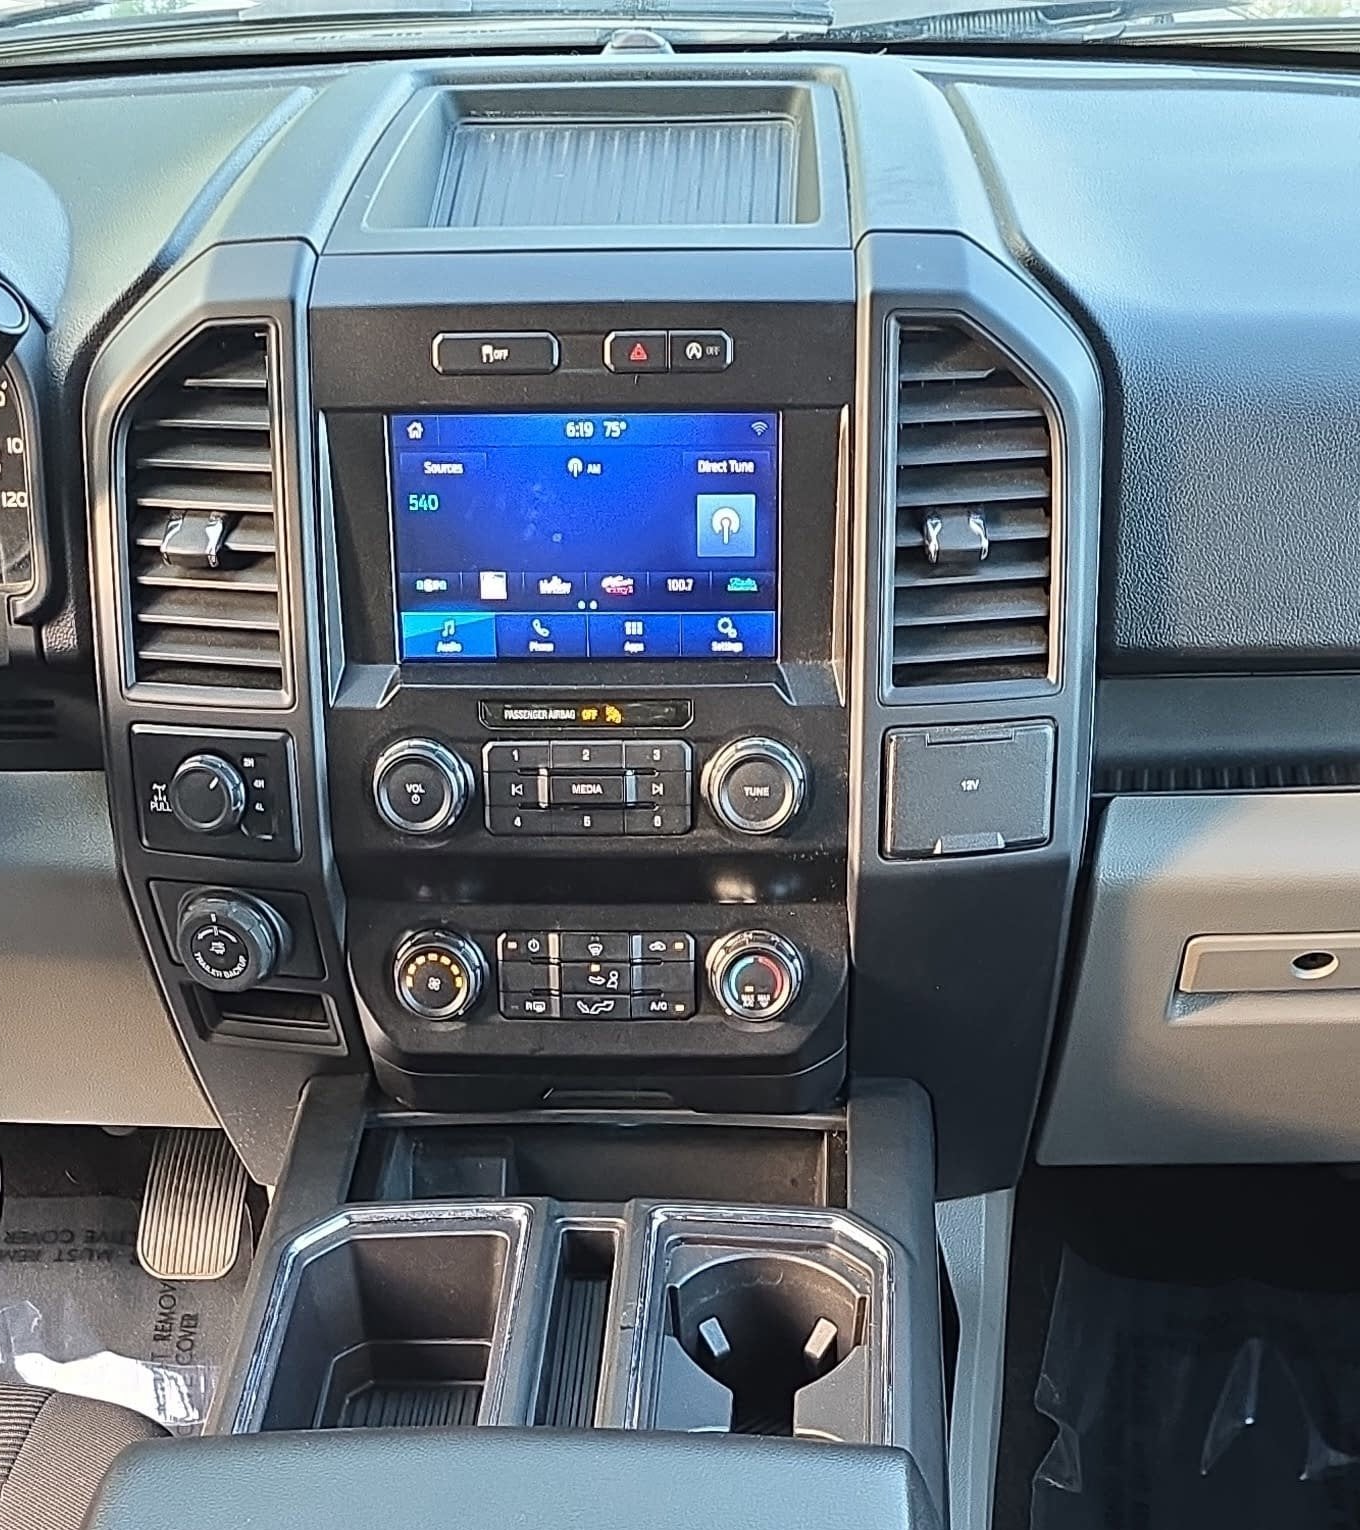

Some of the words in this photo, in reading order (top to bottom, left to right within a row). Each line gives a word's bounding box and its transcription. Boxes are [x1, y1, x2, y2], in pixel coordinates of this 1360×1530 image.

[566, 420, 595, 438] 6:19
[6, 437, 24, 454] 10
[423, 460, 465, 475] Sources
[586, 463, 602, 475] AM
[697, 458, 728, 474] Direct
[729, 459, 755, 474] Tune
[1, 490, 29, 508] 120
[408, 494, 439, 512] 540
[666, 578, 694, 593] 100.7
[503, 708, 547, 721] PASSENGER
[548, 708, 576, 721] AIRBAG
[580, 708, 599, 721] OFF
[512, 749, 520, 762] 1
[581, 748, 591, 762] 2
[652, 748, 662, 761] 3
[405, 782, 426, 794] VOL
[571, 783, 604, 796] MEDIA
[743, 785, 771, 798] TUNE
[960, 779, 980, 791] 12V
[150, 800, 173, 813] PULL
[513, 815, 523, 828] 4
[222, 955, 247, 979] BACKUP
[650, 1002, 669, 1013] A/C
[3, 1229, 73, 1245] COVER
[152, 1281, 177, 1342] REMOV
[175, 1312, 199, 1366] COVER
